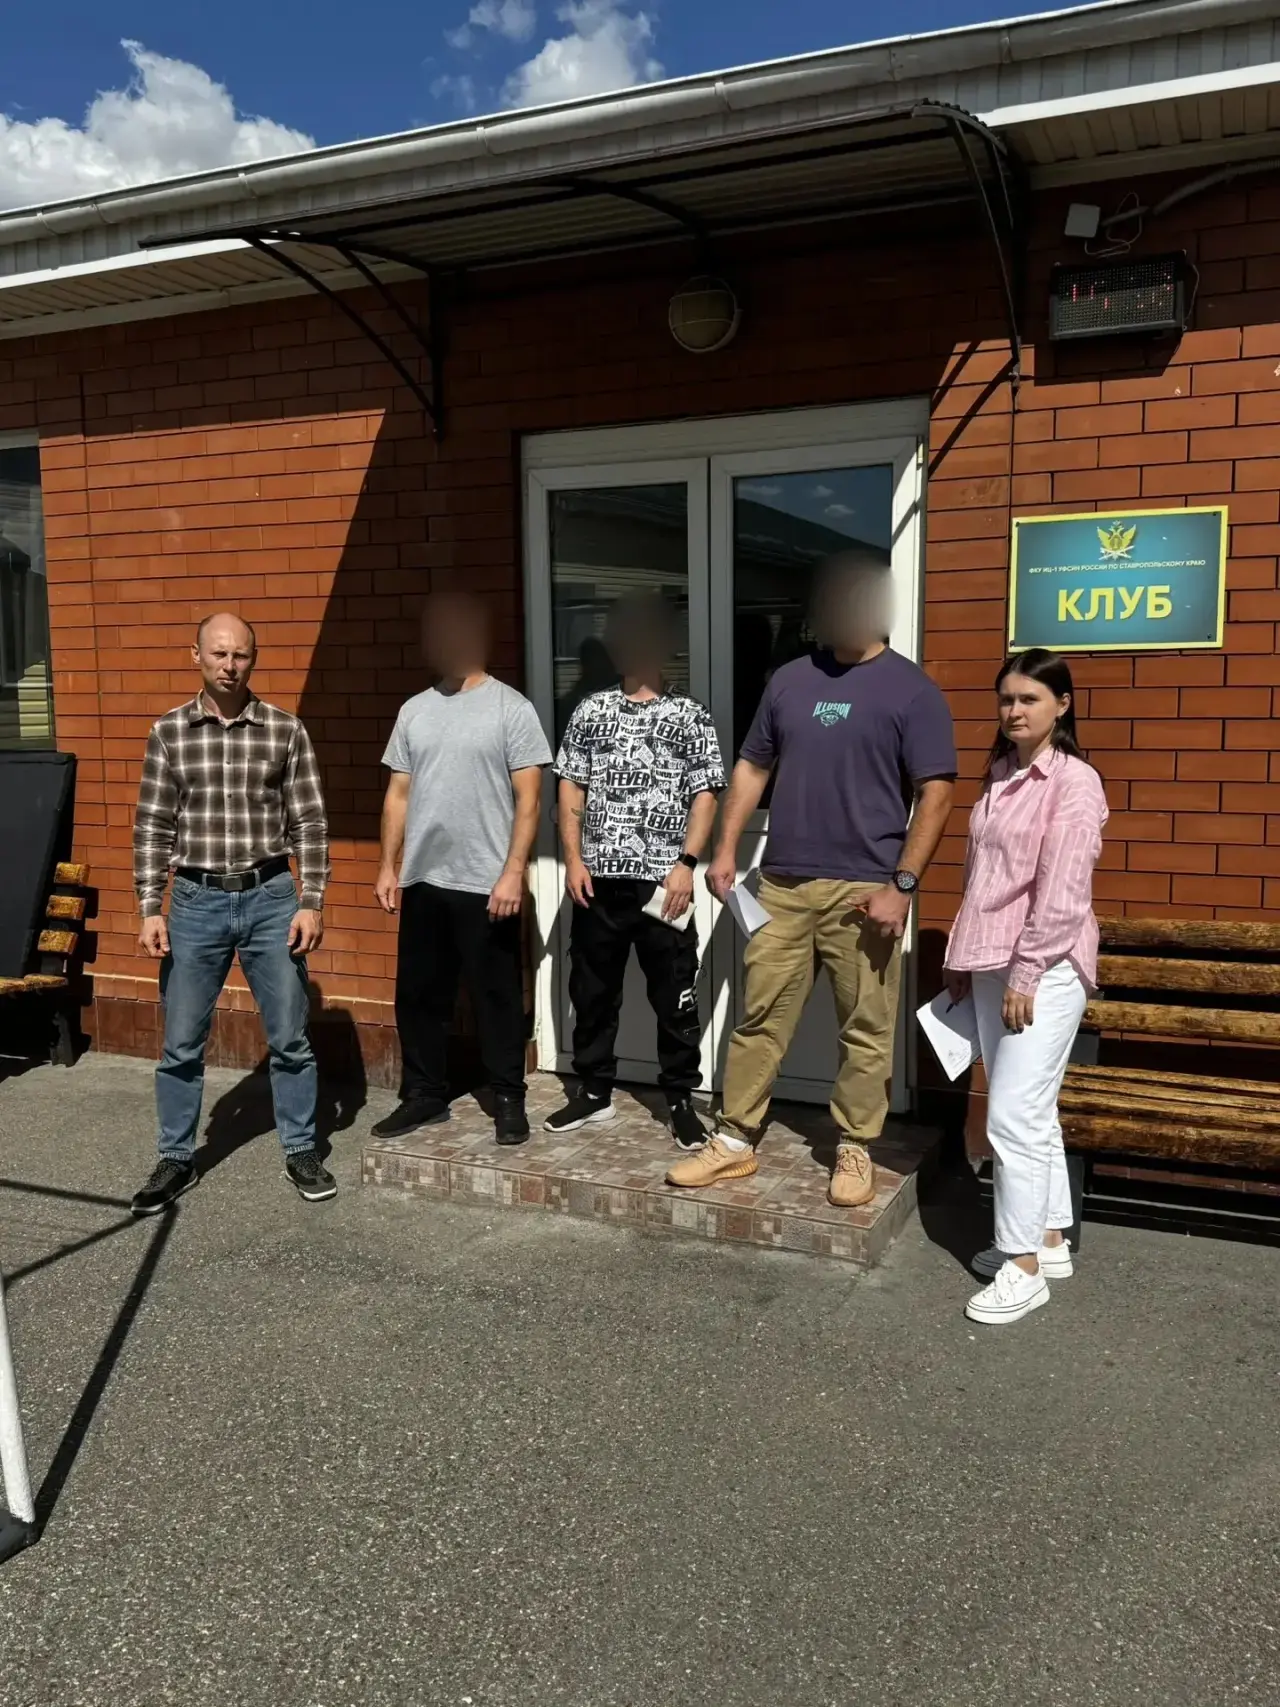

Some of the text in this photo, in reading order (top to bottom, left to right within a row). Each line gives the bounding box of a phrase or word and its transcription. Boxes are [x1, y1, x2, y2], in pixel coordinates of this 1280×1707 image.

[1081, 564, 1108, 572] РОССИИ
[1118, 561, 1185, 569] СТАВРОПОЛЬСКОМУ
[1185, 559, 1206, 567] КРАЮ
[1057, 585, 1173, 622] КЛУБ
[812, 701, 852, 720] ILLUSION
[611, 771, 650, 787] FEVER
[648, 814, 684, 830] FEVER
[601, 860, 643, 874] FEVER
